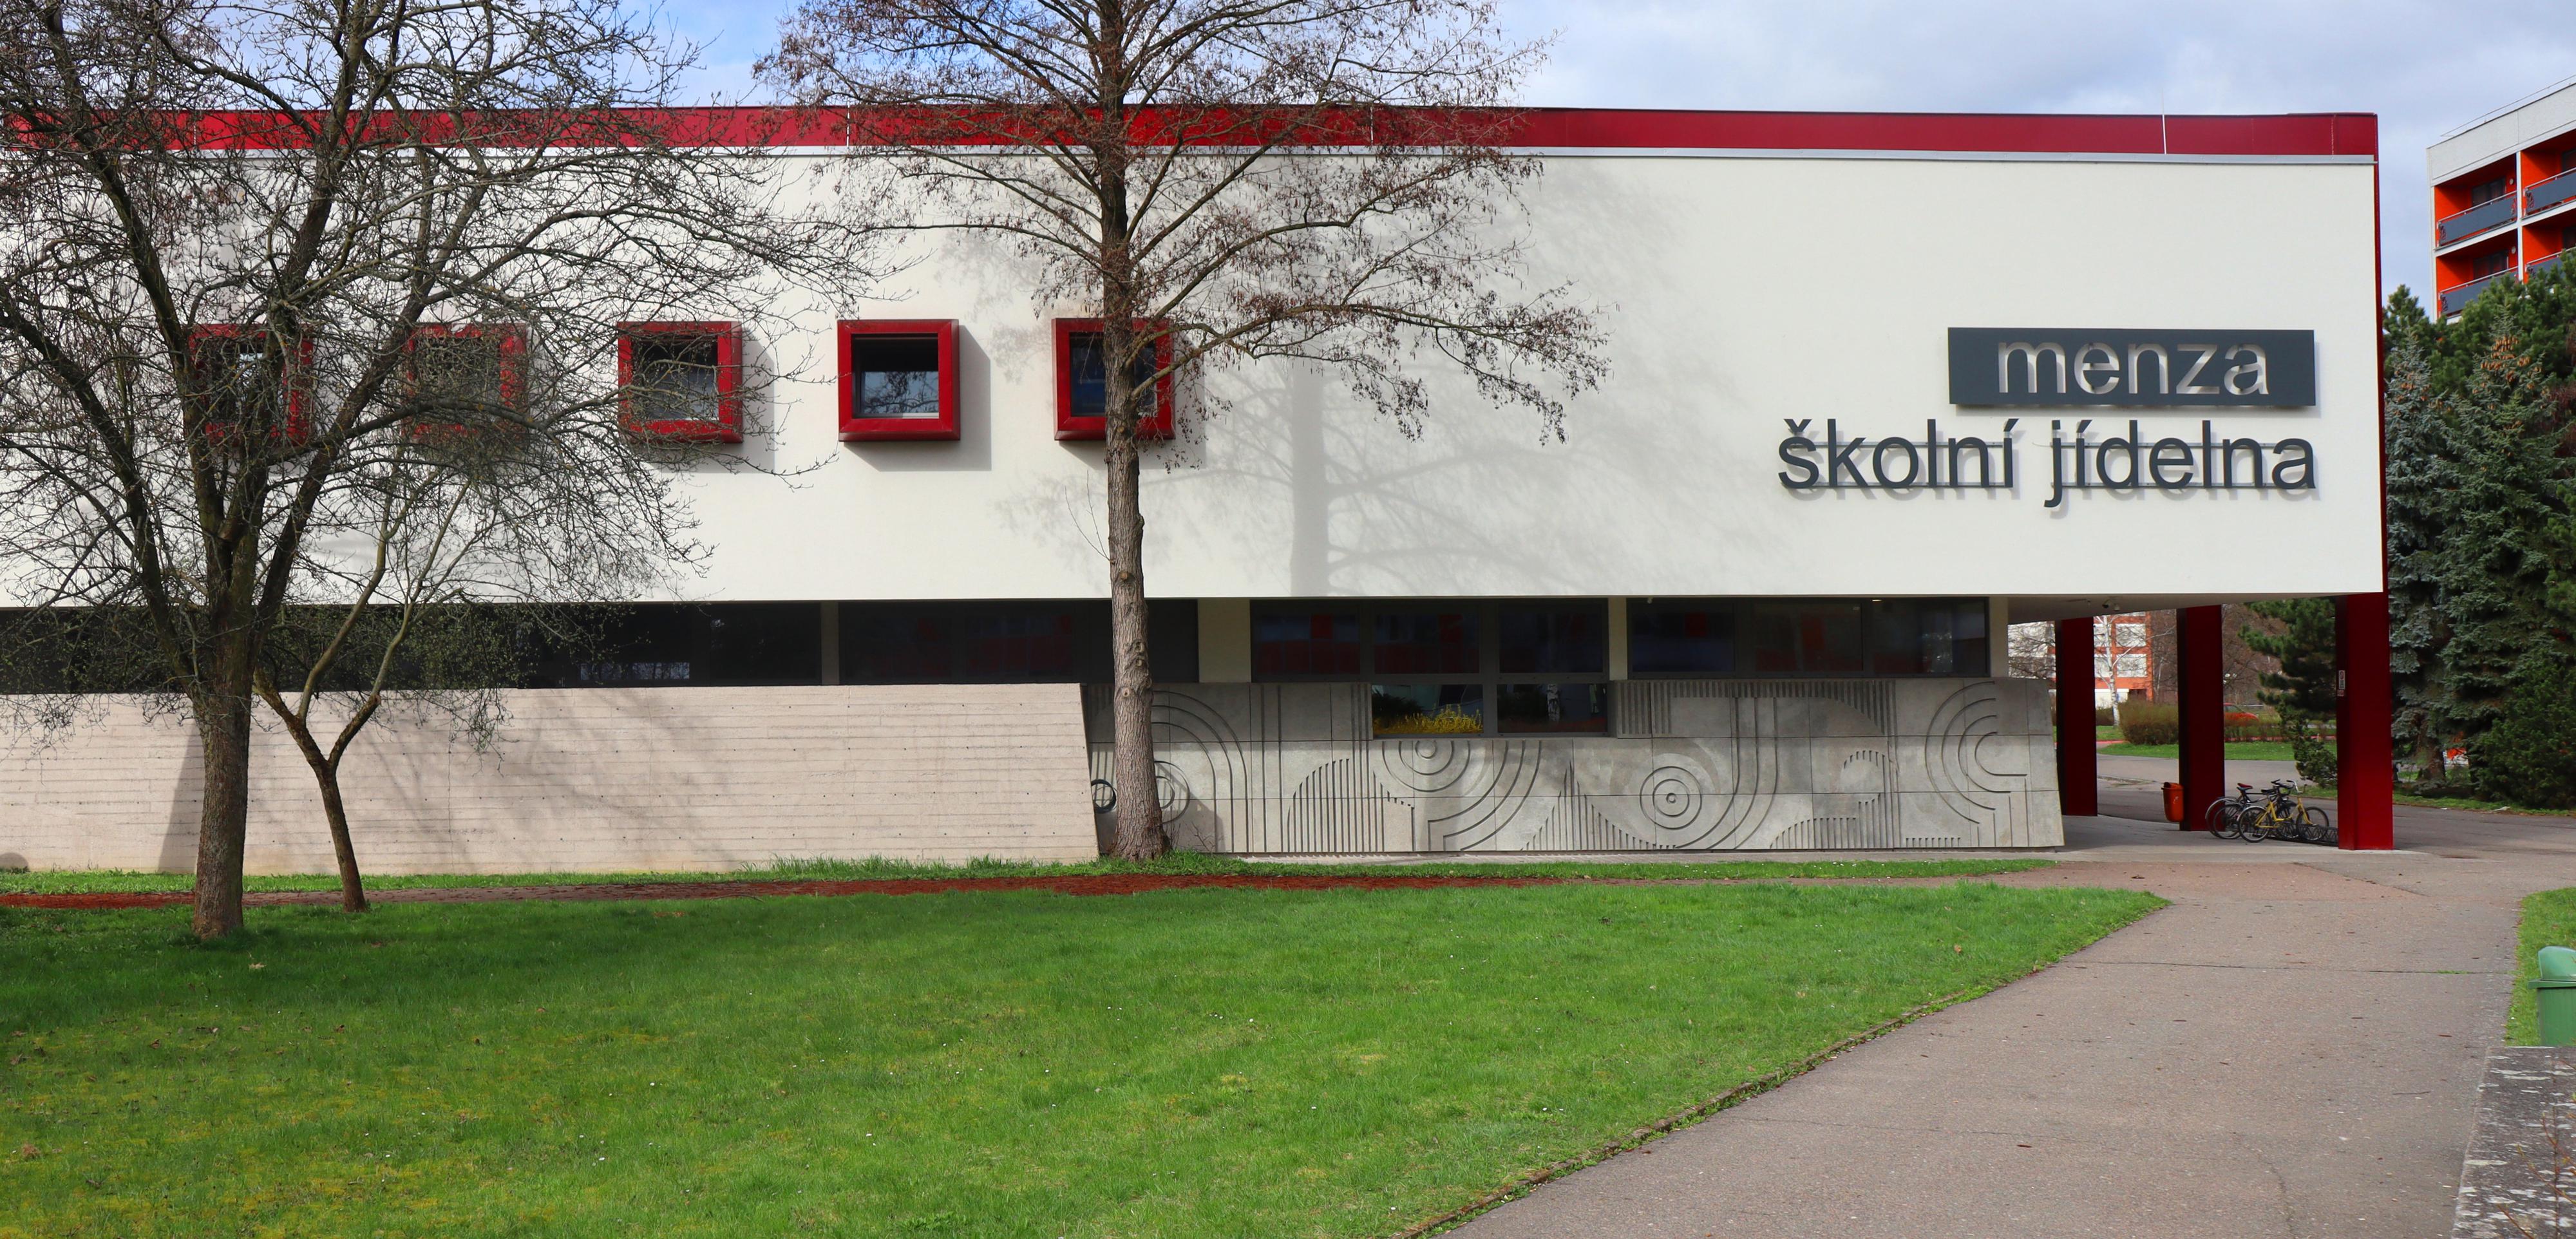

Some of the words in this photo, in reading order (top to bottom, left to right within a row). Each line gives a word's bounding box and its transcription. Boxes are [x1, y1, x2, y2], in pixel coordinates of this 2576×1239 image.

[1997, 341, 2270, 395] menza
[1778, 419, 2019, 489] školní
[2043, 419, 2316, 508] jídelna
